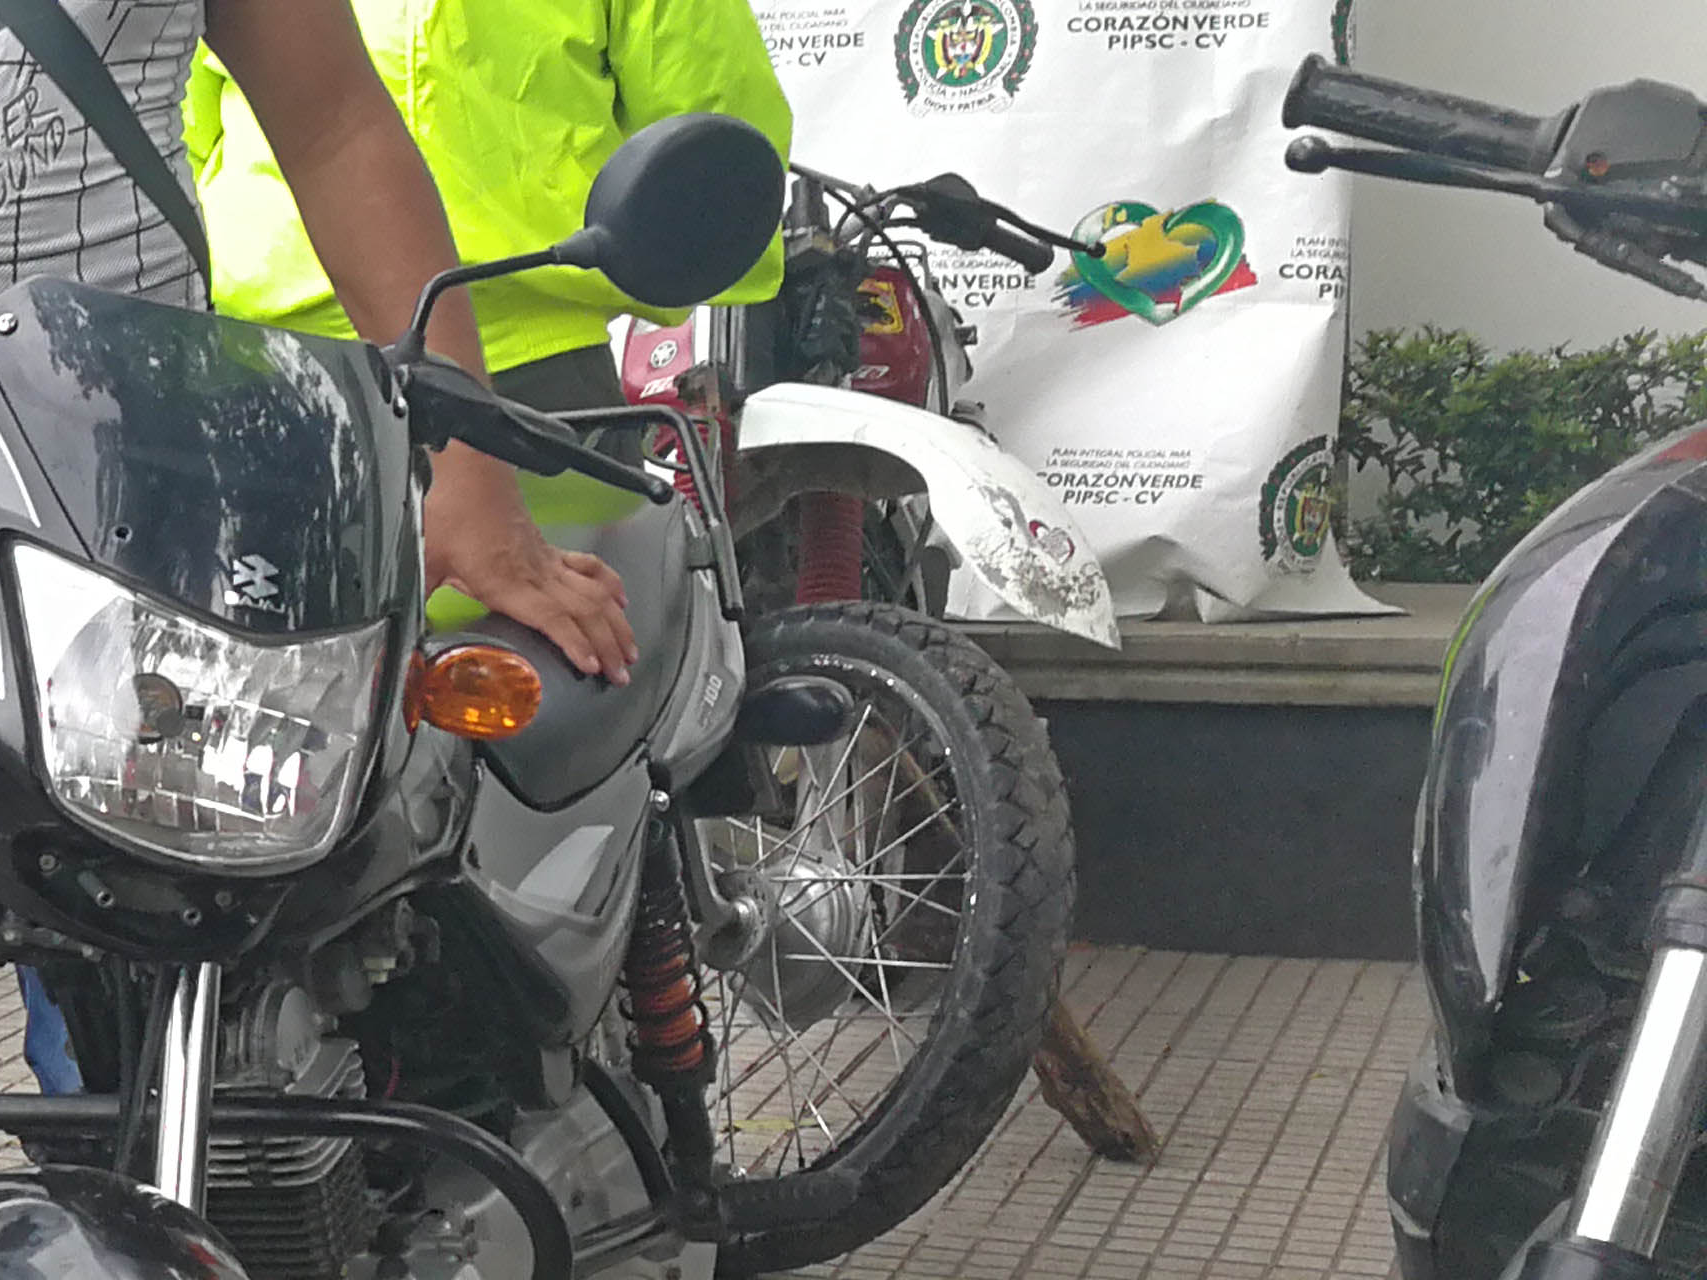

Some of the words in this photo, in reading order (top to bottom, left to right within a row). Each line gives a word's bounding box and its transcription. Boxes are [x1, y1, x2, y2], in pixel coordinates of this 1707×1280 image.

[1067, 11, 1188, 33] CORAZÓN
[1192, 12, 1270, 30] VERDE
[798, 32, 865, 49] VERDE
[1108, 33, 1175, 50] PIPSC
[1195, 33, 1227, 49] CV
[798, 51, 826, 66] CV
[962, 274, 1036, 290] VERDE
[964, 292, 996, 307] CV
[1139, 474, 1203, 488] VERDE
[1063, 490, 1119, 504] PIPSC
[1135, 491, 1163, 504] CV
